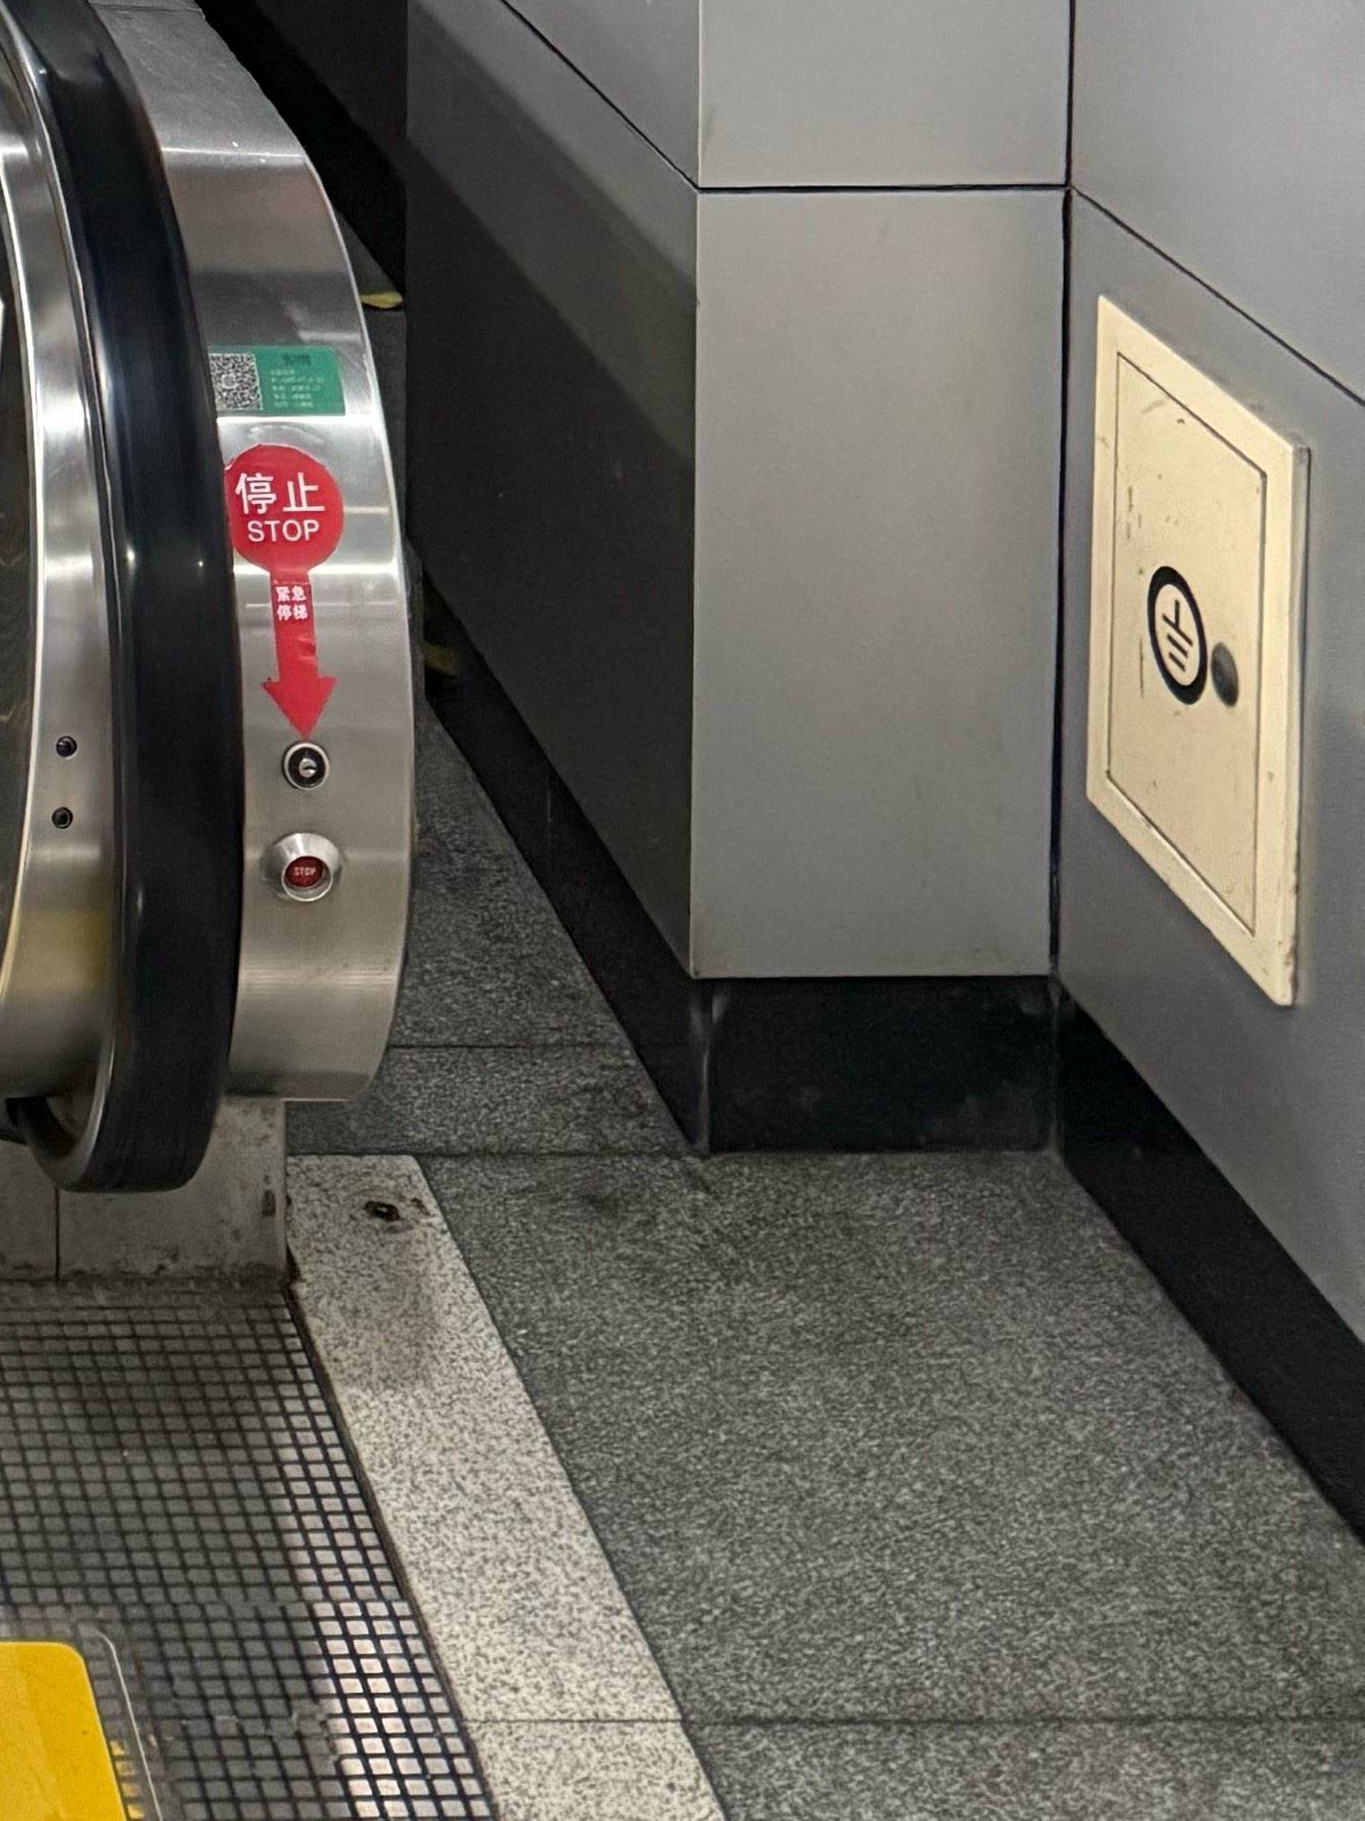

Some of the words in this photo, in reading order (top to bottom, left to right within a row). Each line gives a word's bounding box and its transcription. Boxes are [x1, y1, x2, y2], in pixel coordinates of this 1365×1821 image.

[235, 472, 326, 515] 停止
[247, 519, 320, 542] STOP
[275, 585, 307, 602] 紧急
[276, 604, 309, 621] 停梯
[293, 866, 317, 877] STOP
